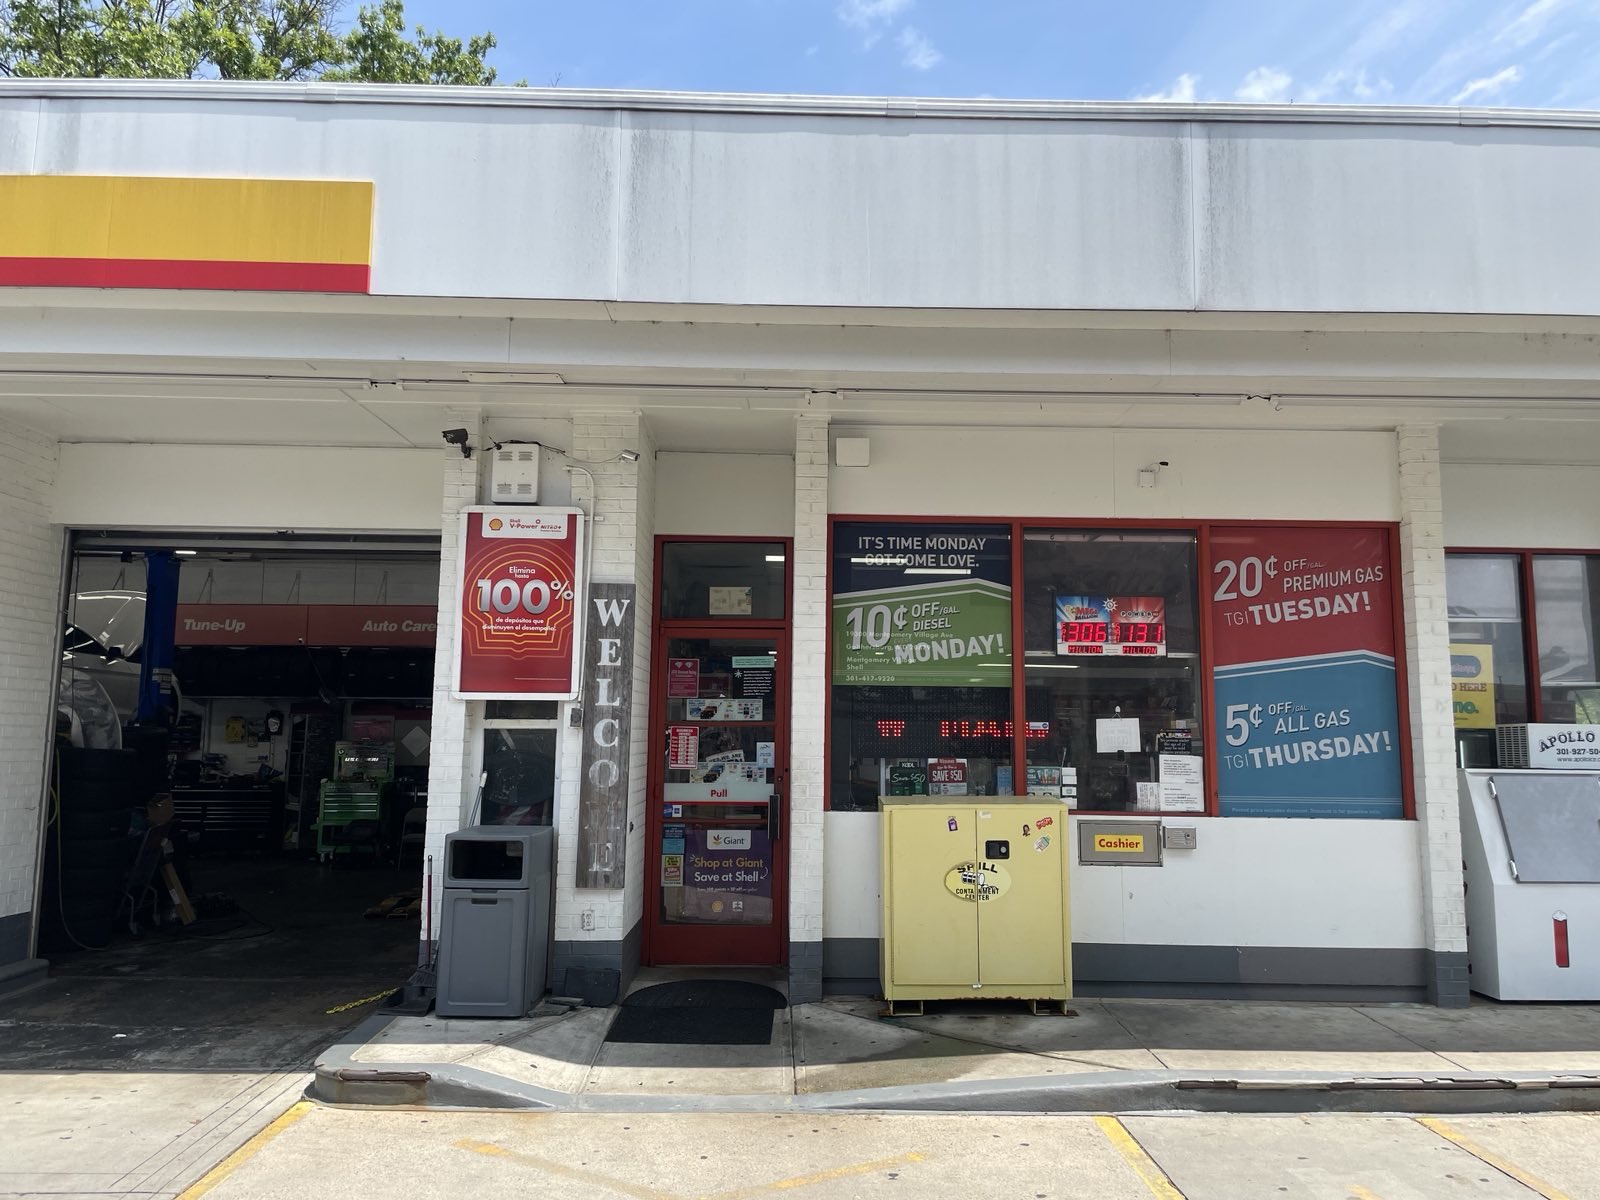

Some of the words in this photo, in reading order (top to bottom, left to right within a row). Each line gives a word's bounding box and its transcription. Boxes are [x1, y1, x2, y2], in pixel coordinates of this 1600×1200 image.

[858, 536, 884, 550] IT'S
[887, 537, 921, 550] TIME
[925, 537, 986, 550] MONDAY
[865, 554, 894, 566] GOT
[898, 554, 936, 566] SOME
[940, 554, 979, 567] LOVE.
[509, 566, 536, 574] Elimina
[1213, 555, 1279, 602] 20¢
[1283, 570, 1351, 594] PREMIUM
[1355, 565, 1384, 584] GAS
[477, 578, 574, 614] 100%
[184, 619, 246, 632] Tune-Up
[362, 620, 398, 632] Auto
[401, 620, 436, 632] Care
[504, 616, 532, 624] depósitos
[913, 617, 952, 631] DIESEL
[846, 604, 909, 650] 10¢
[1068, 623, 1106, 642] 306
[1128, 624, 1162, 643] 131
[894, 633, 1004, 664] MONDAY!
[1123, 646, 1157, 654] MILLION
[847, 656, 890, 664] Montgomery
[1460, 682, 1487, 692] HERE
[1225, 703, 1263, 746] 5¢
[1274, 715, 1310, 735] ALL
[1314, 709, 1351, 729] GAS
[1539, 731, 1595, 752] APOLLO
[932, 770, 950, 782] SAVE
[950, 770, 963, 781] $50
[711, 789, 728, 798] Pull
[723, 836, 744, 845] Giant
[1098, 838, 1140, 849] Cashier
[694, 856, 720, 870] Shop
[722, 858, 733, 868] at
[736, 857, 764, 868] Giant
[957, 862, 998, 874] SPILL
[694, 871, 720, 882] Save
[721, 872, 733, 882] at
[735, 870, 759, 882] Shell
